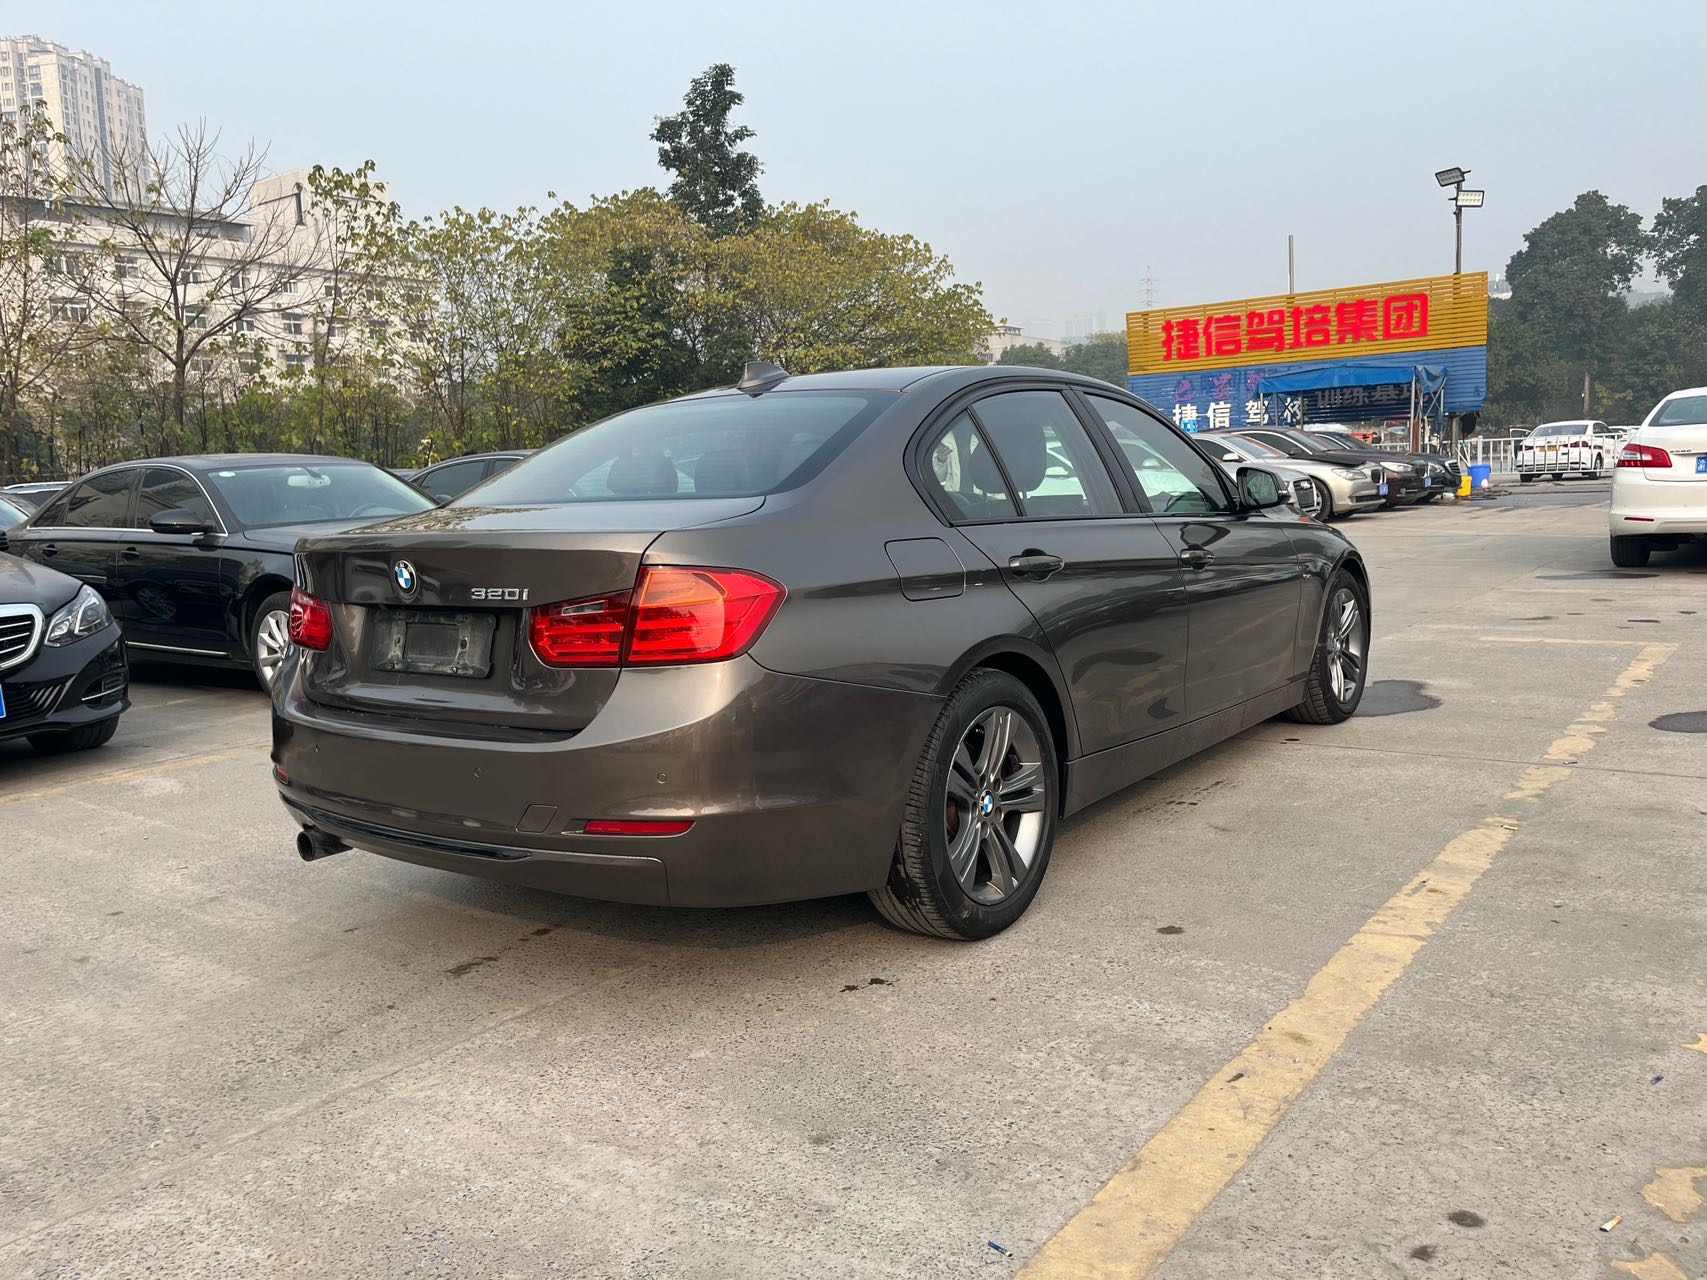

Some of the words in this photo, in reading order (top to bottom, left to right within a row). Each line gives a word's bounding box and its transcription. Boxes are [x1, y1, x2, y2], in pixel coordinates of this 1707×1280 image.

[1161, 293, 1430, 361] 捷信驾培集团
